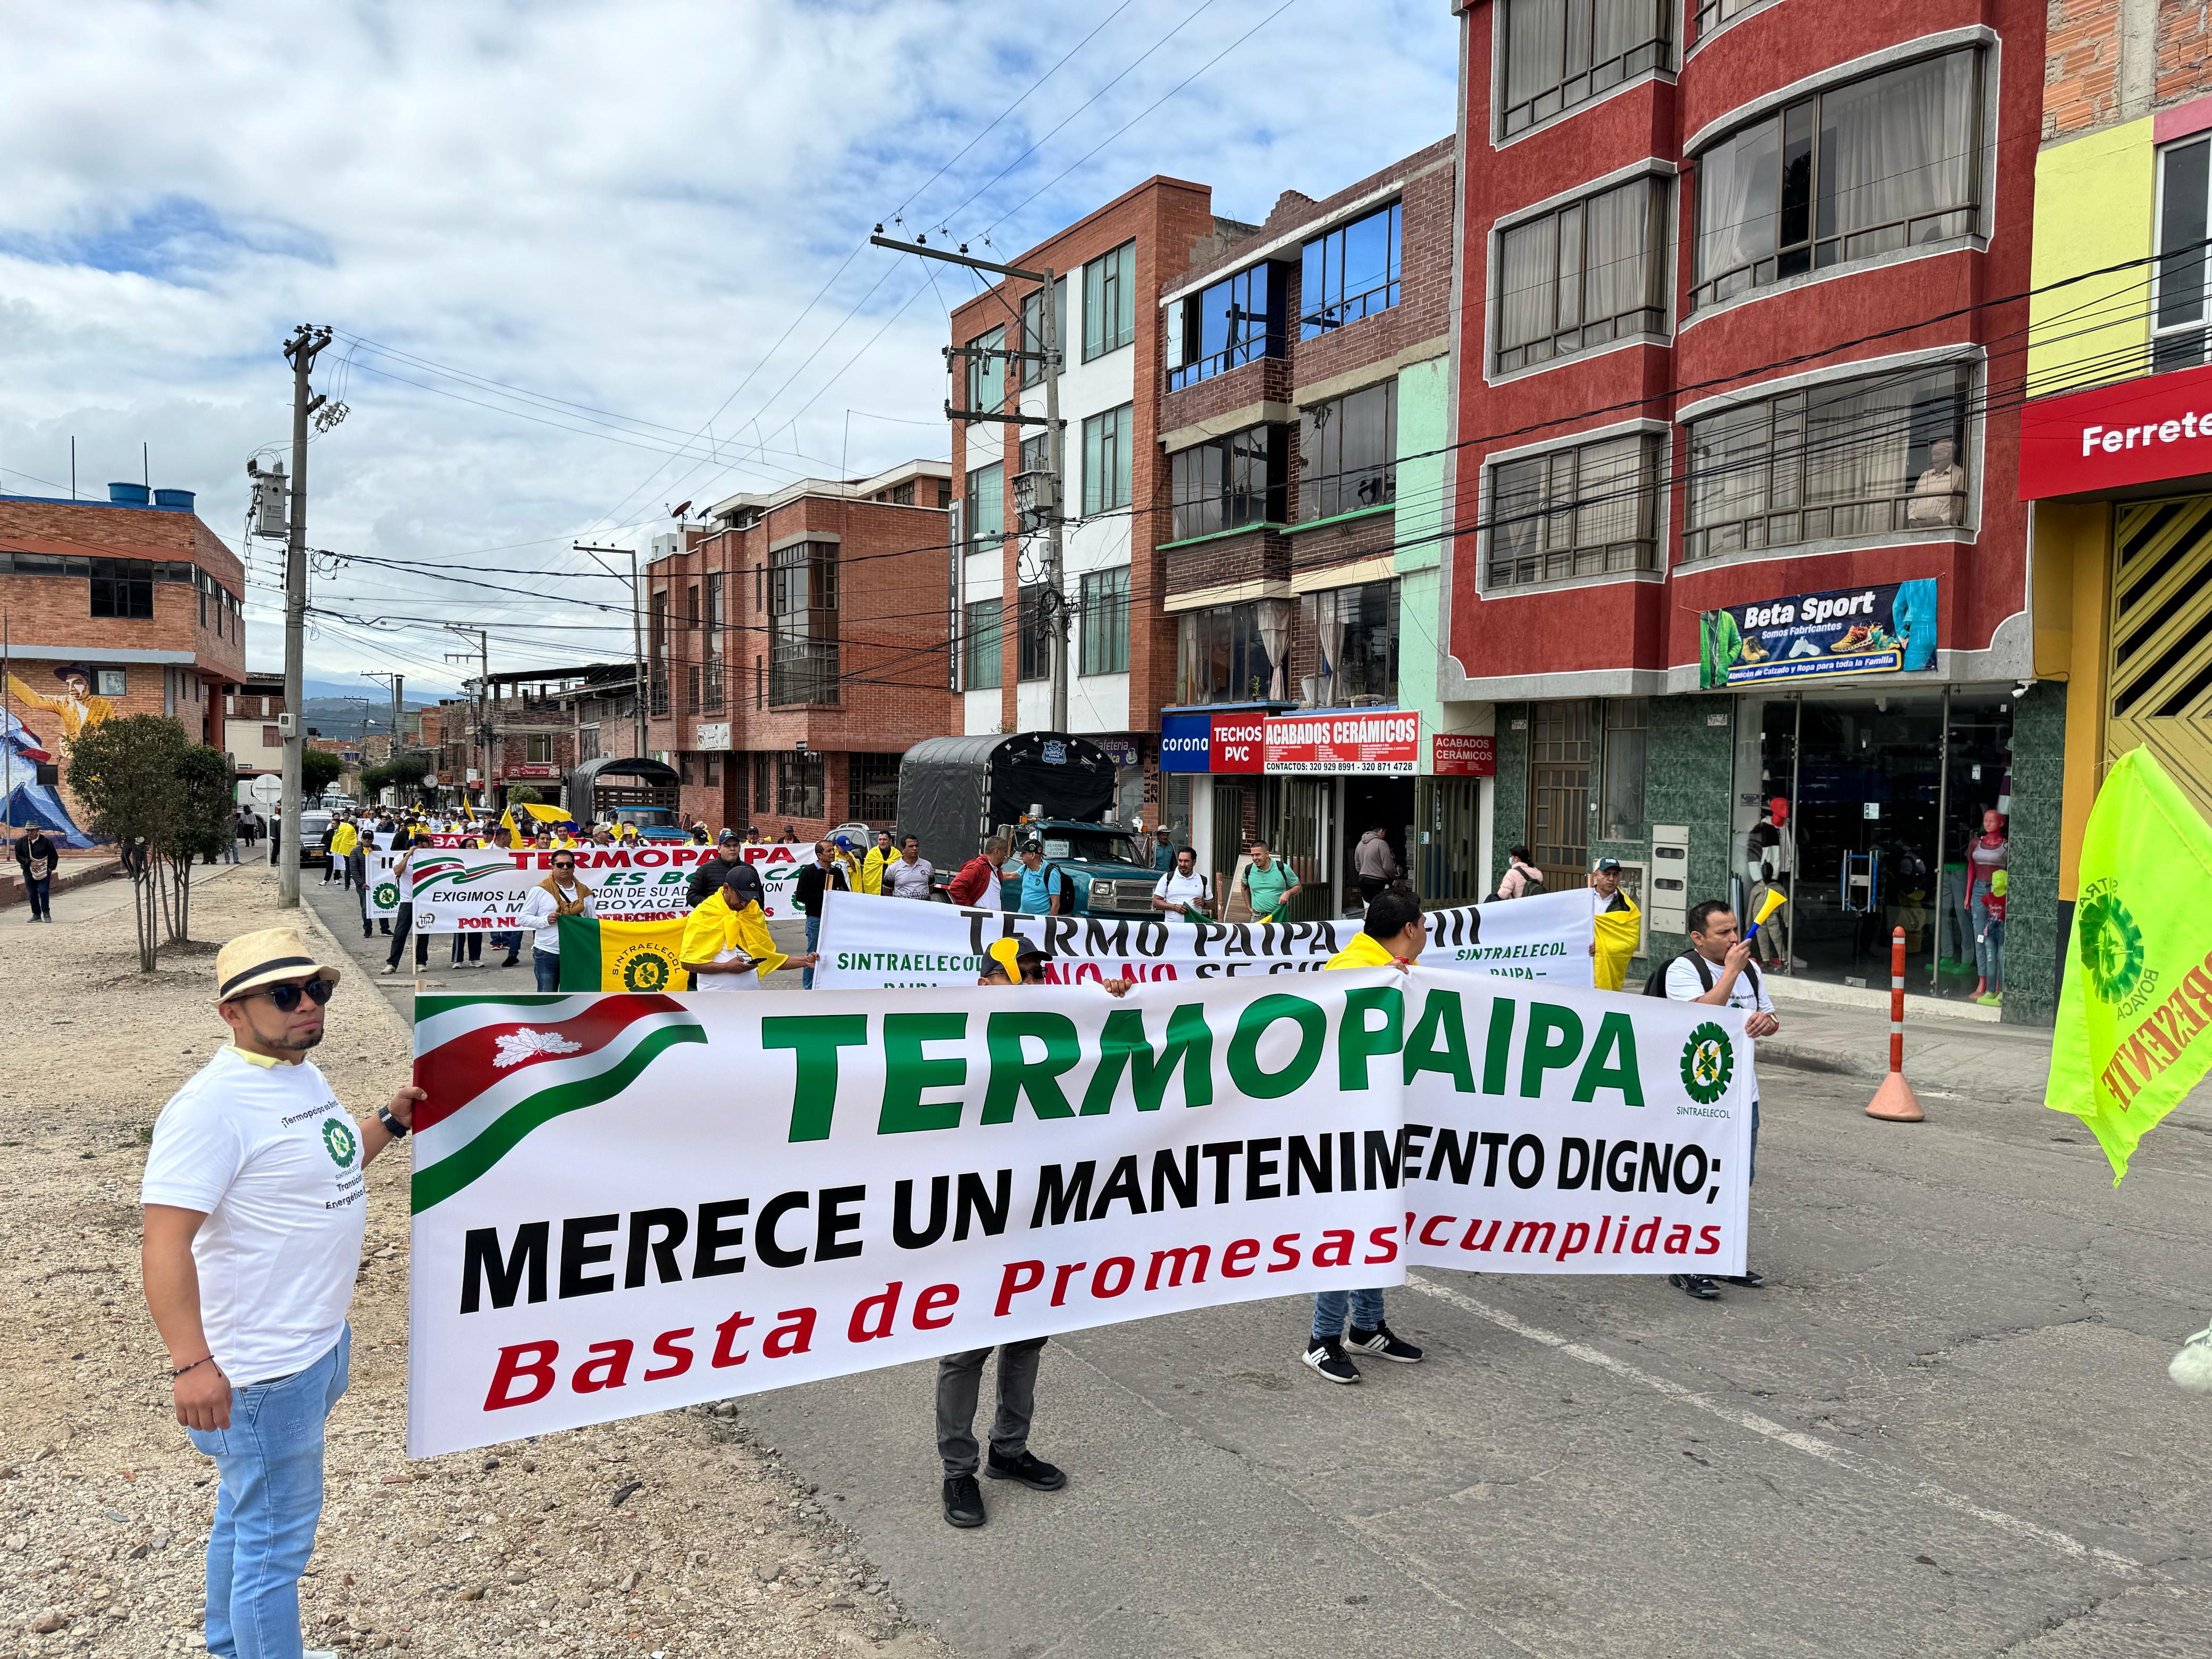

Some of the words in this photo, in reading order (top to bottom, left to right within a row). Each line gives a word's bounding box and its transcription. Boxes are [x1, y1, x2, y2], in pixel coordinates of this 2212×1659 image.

[2083, 412, 2212, 457] Ferrete
[1744, 604, 1795, 629] Beta
[1801, 591, 1875, 624] Sport
[1762, 628, 1788, 639] Somos
[1789, 622, 1842, 635] Fabricantes
[1763, 666, 1789, 675] Calzado
[1797, 664, 1815, 673] Ropa
[1816, 663, 1834, 671] para
[1864, 655, 1893, 666] Familia
[1214, 726, 1262, 742] TECHOS
[1266, 722, 1330, 745] ACABADOS
[1333, 717, 1415, 744] CERÁMICOS
[1162, 738, 1209, 751] corona
[1436, 738, 1489, 749] ACABADOS
[1225, 746, 1250, 761] PVC
[1436, 748, 1493, 760] CERÁMICOS
[509, 847, 797, 870] TERMOPAPA
[604, 873, 647, 886] ES
[432, 891, 504, 902] EXIGIMOS
[508, 891, 526, 900] LA
[627, 887, 646, 897] DE
[650, 887, 668, 896] SU
[482, 904, 497, 913] A
[458, 917, 493, 929] POR
[960, 910, 1169, 957] TERMO
[1194, 921, 1339, 956] PAIPA
[613, 943, 682, 975] SINTRAELECOL
[1455, 942, 1567, 961] SINTRAELECOL
[837, 952, 982, 971] SINTRAELECOL
[762, 986, 1645, 1143] TERMOPAIPA
[1677, 1106, 1731, 1118] SINTRAELECOL
[460, 1184, 866, 1314] MERECE
[892, 1168, 1012, 1249] UN
[1557, 1137, 1721, 1204] DIGNO;
[483, 1306, 817, 1411] Basta
[848, 1281, 959, 1343] de
[994, 1226, 1398, 1317] Promesas
